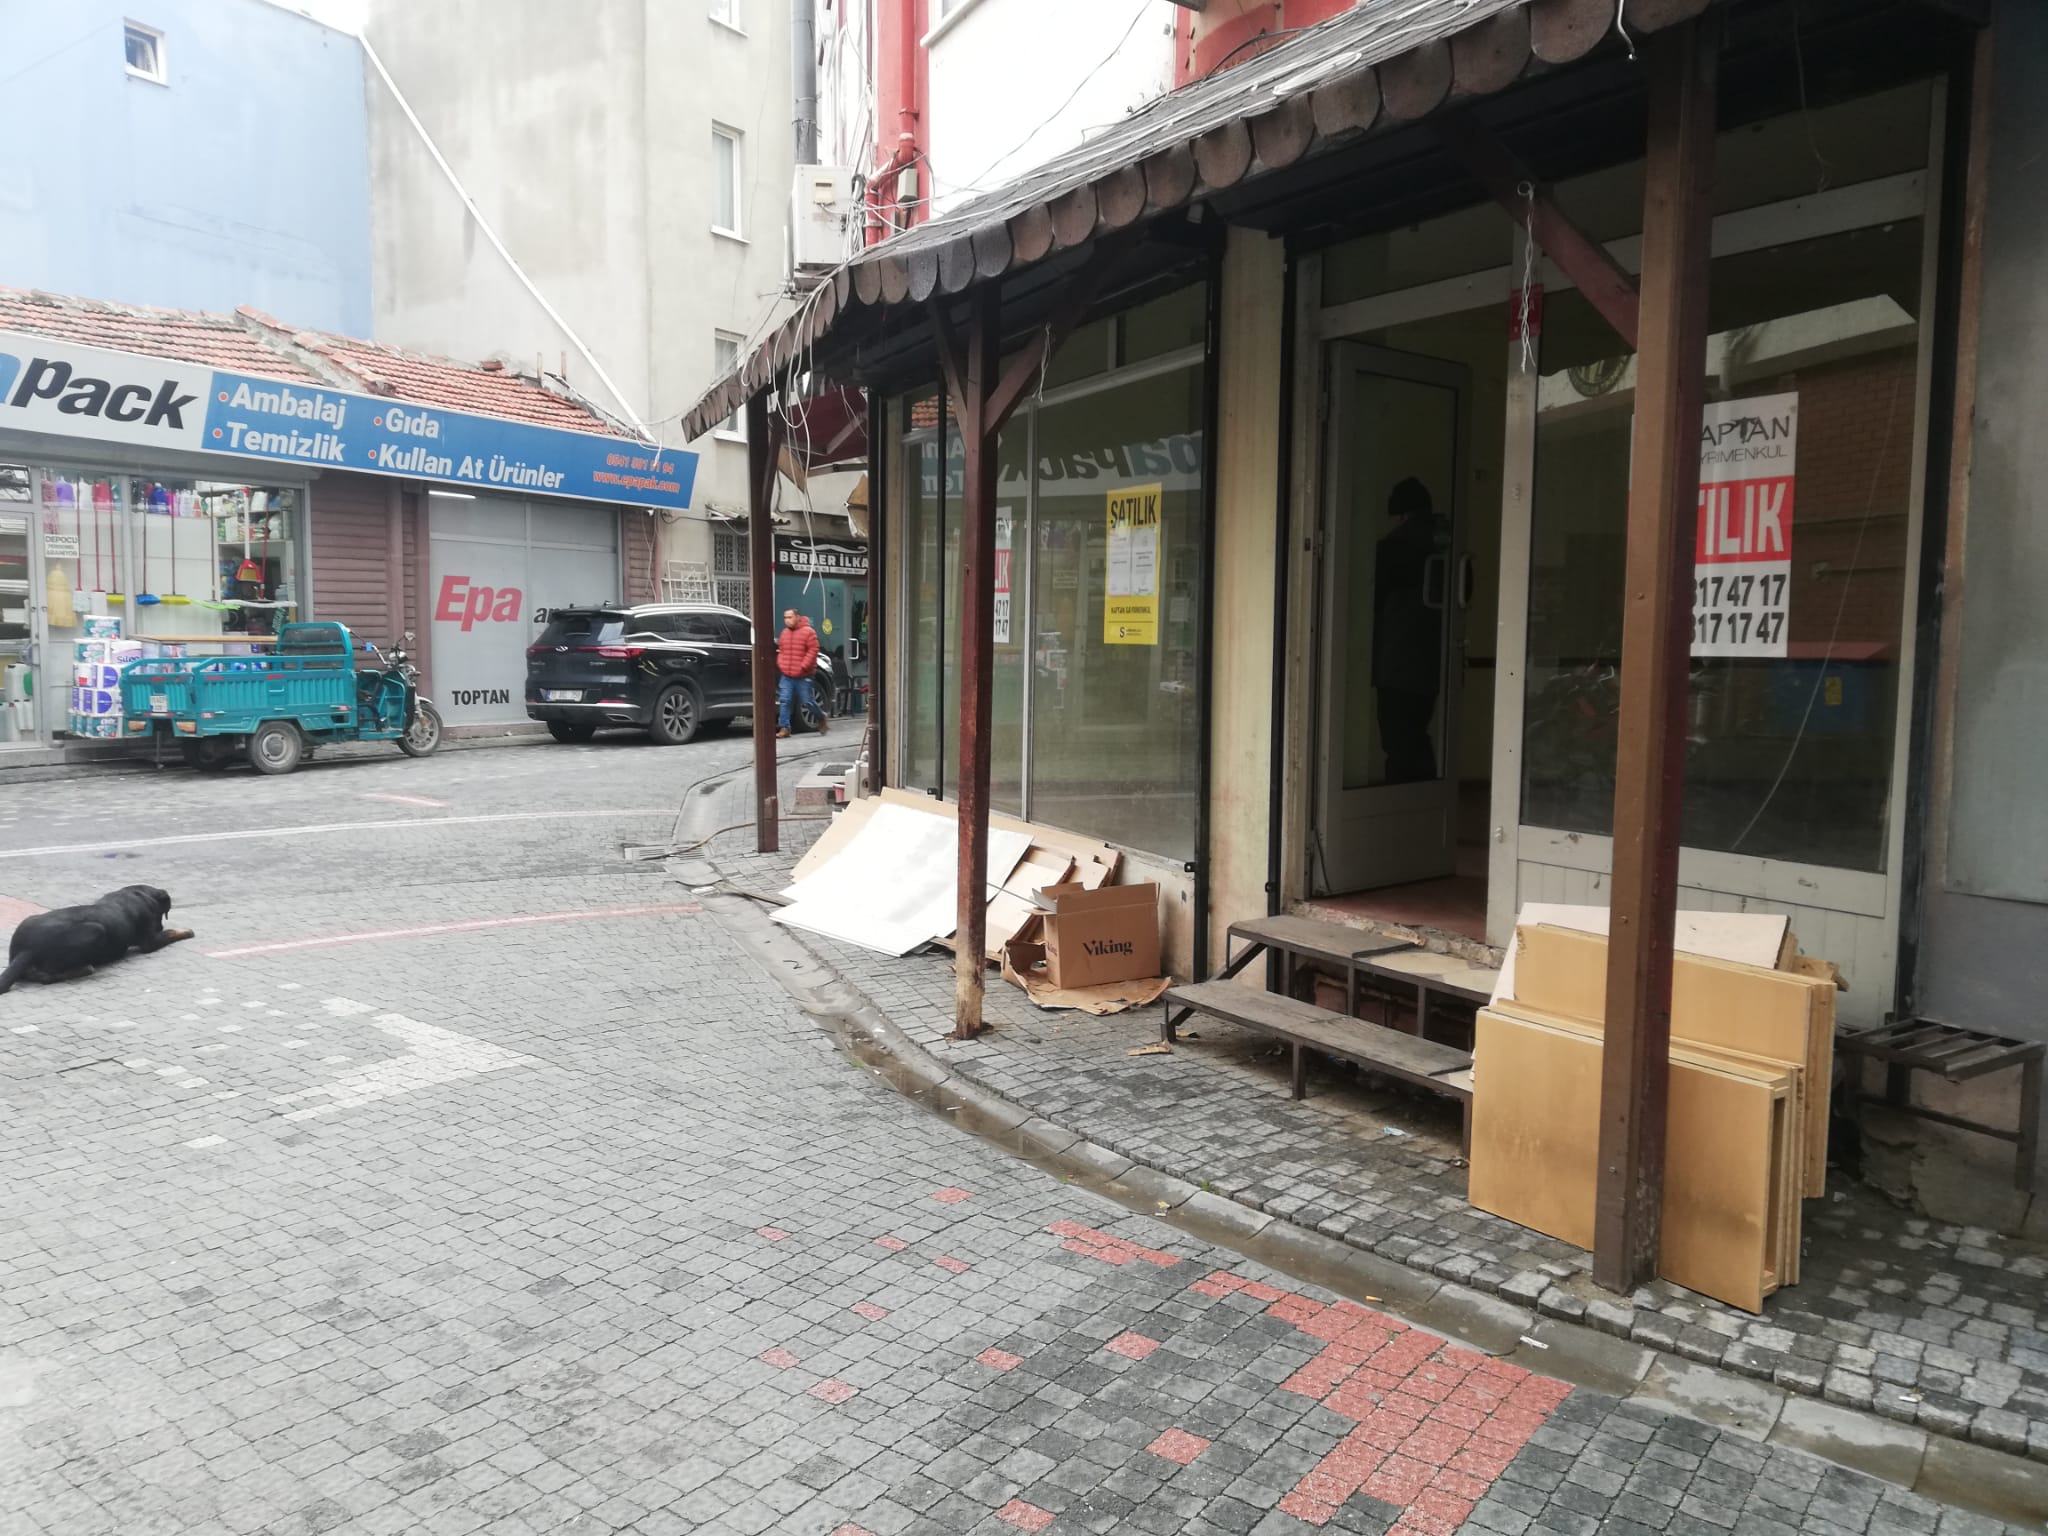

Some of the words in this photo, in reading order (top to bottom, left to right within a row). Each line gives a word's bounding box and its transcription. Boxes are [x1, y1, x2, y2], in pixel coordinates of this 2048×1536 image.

[10, 357, 198, 430] pack
[229, 382, 347, 430] Ambalaj
[385, 407, 440, 440] Gıda
[1700, 415, 1790, 447] APTAN
[226, 421, 346, 463] Temizlik
[1700, 444, 1789, 465] YRIMENKUL
[378, 443, 453, 476] Kullan
[456, 456, 483, 481] At
[488, 454, 565, 490] Ürünler
[1110, 494, 1157, 529] SATILIK
[1698, 482, 1787, 556] ILIK
[434, 575, 523, 632] Epa
[1694, 576, 1724, 607] 17
[1726, 575, 1755, 607] 47
[1759, 573, 1787, 606] 17
[1692, 613, 1723, 644] 17
[1727, 612, 1753, 644] 17
[1756, 612, 1785, 644] 47
[452, 689, 510, 706] TOPTAN
[1082, 939, 1134, 956] Viking
